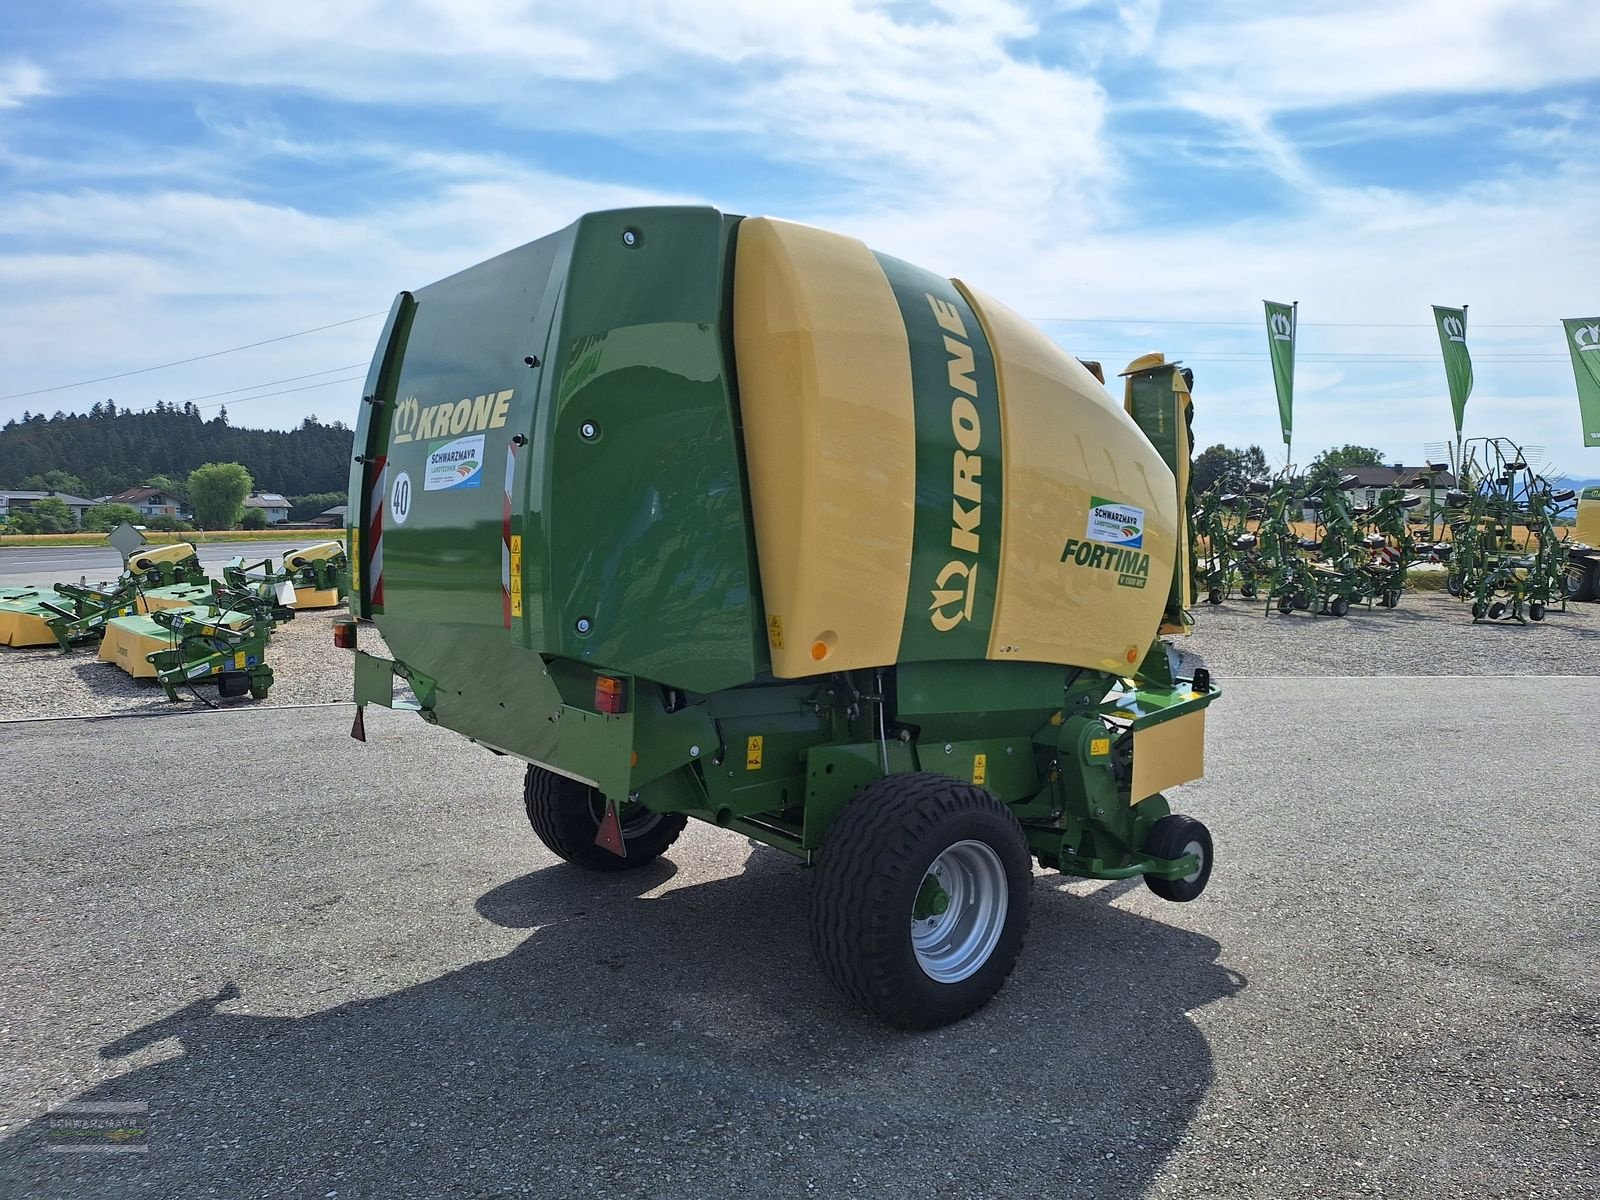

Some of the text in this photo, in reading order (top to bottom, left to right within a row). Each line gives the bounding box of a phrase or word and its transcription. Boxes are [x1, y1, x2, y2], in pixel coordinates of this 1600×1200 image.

[415, 389, 514, 440] KRONE
[927, 292, 982, 554] KRONE
[431, 448, 475, 464] SCHWARZMAYR
[393, 480, 409, 516] 40
[1094, 507, 1138, 526] SCHWARZMAYR
[1060, 539, 1150, 577] FORTIMA
